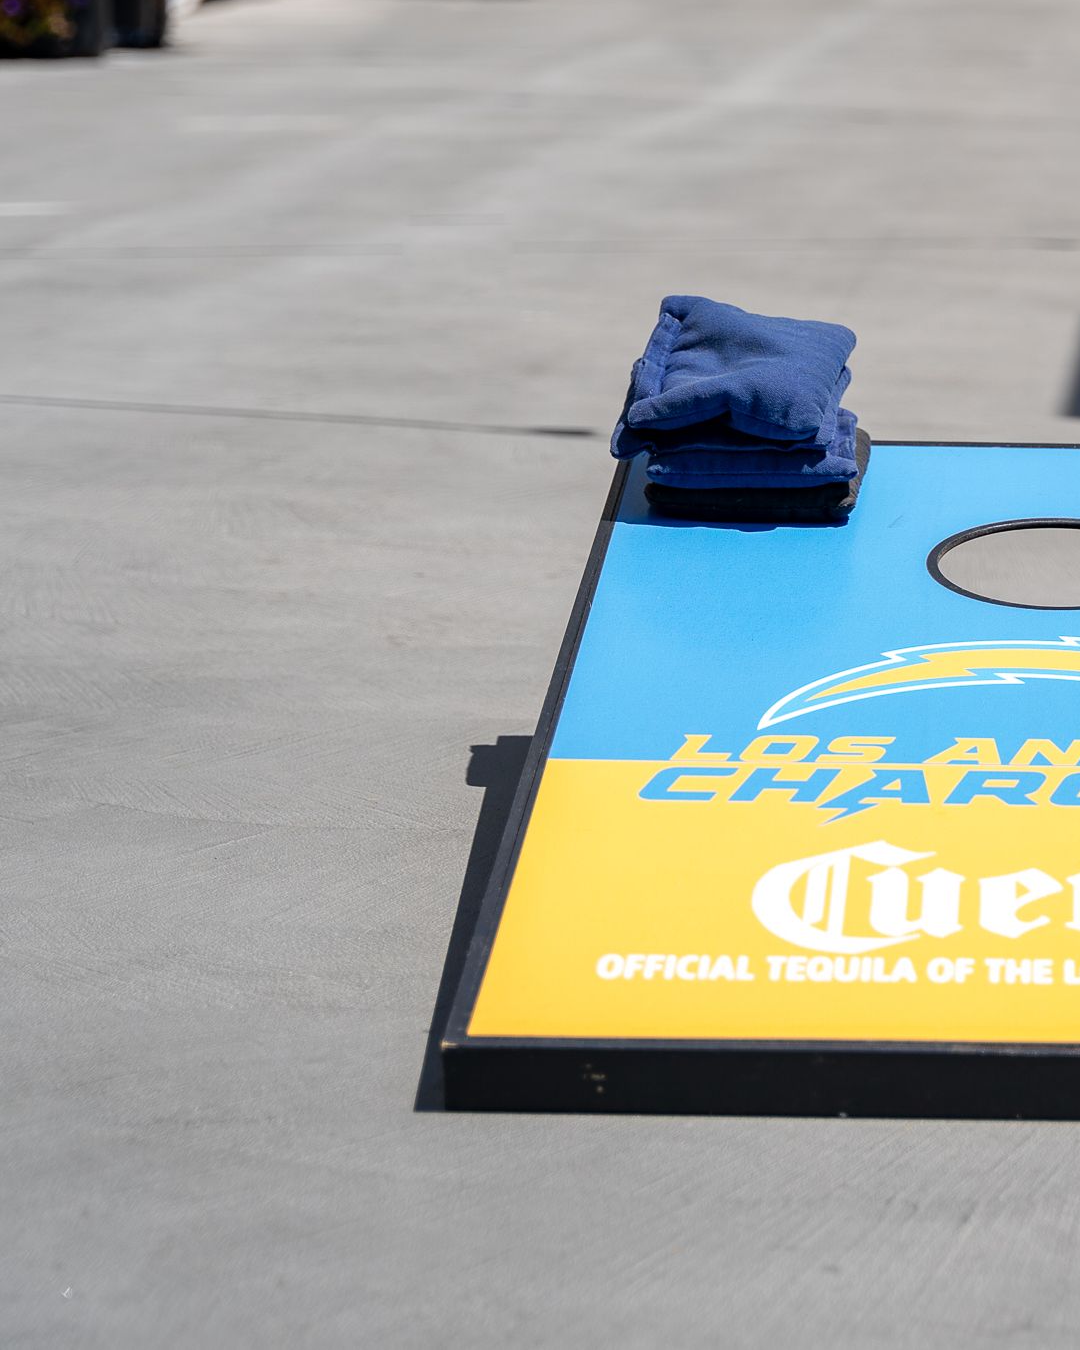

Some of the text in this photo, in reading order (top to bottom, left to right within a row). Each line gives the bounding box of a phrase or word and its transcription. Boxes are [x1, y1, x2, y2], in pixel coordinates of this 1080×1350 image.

[669, 733, 897, 763] LOS
[596, 953, 755, 981] OFFICIAL
[765, 955, 917, 984] TEQUILA
[926, 957, 974, 986] OF
[984, 957, 1053, 986] THE
